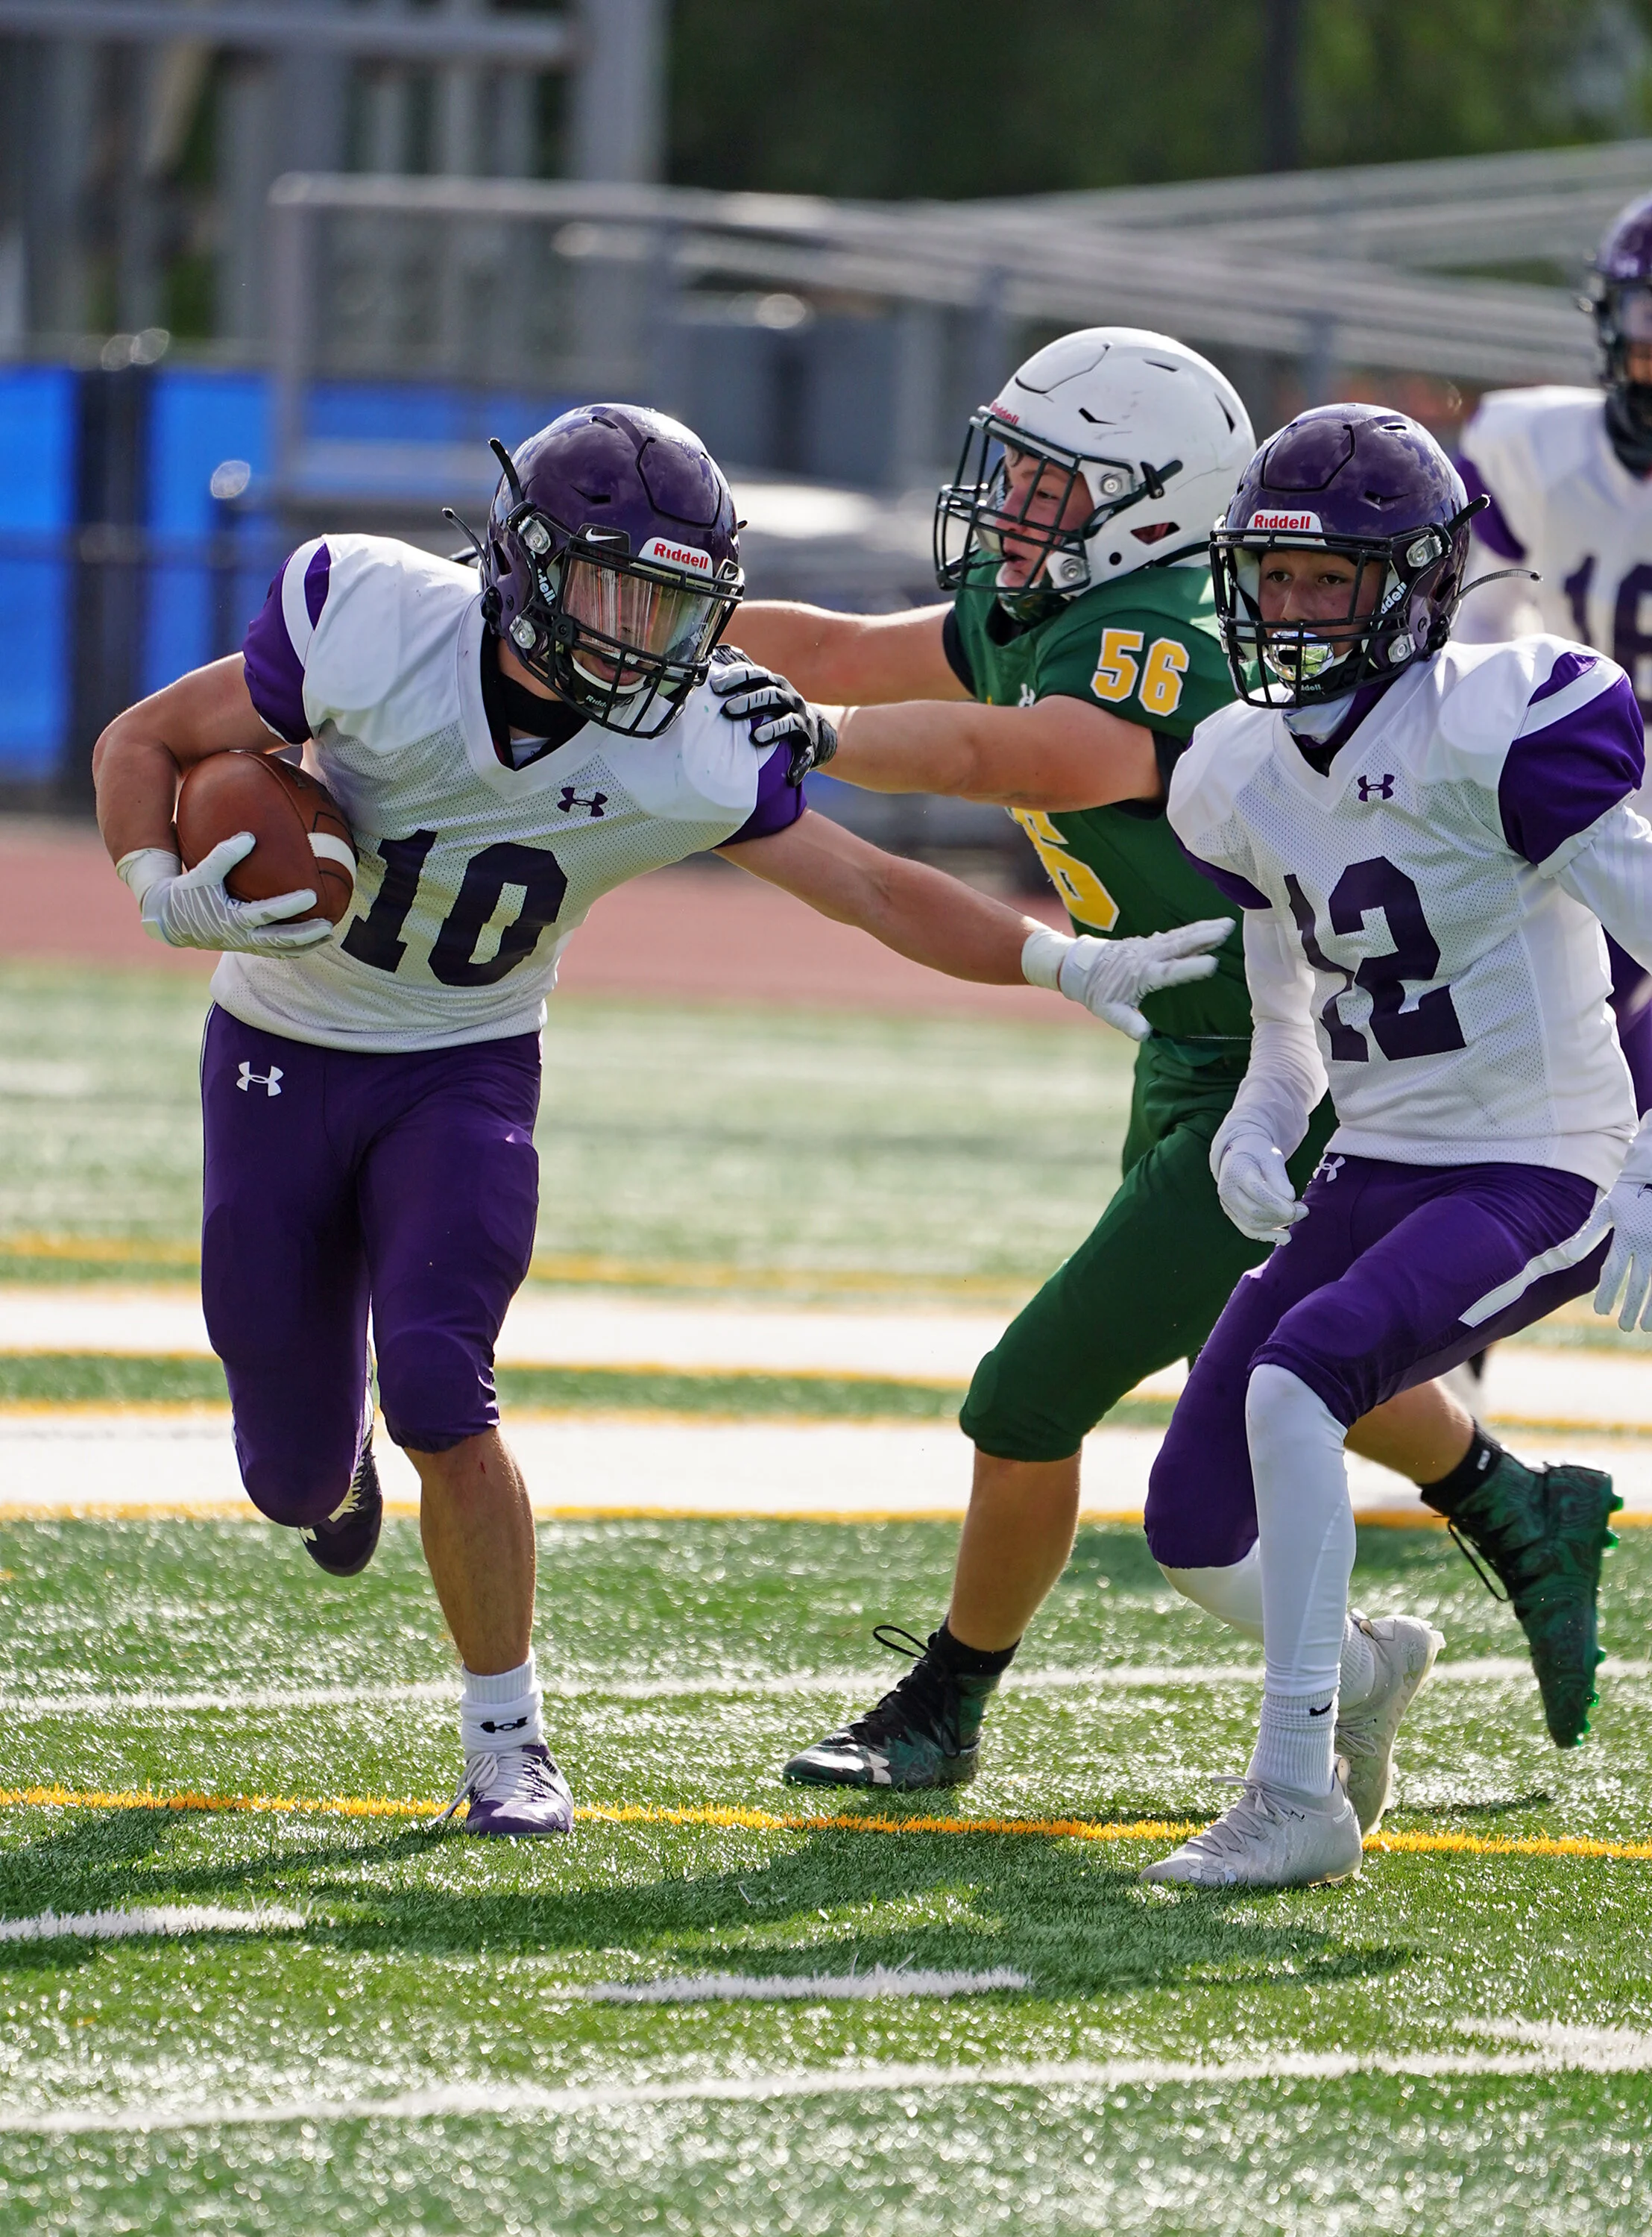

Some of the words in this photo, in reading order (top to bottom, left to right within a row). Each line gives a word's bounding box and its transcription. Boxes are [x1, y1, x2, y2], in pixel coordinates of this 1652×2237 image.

[654, 543, 708, 570] Riddell
[1254, 515, 1311, 529] Riddell
[1090, 628, 1190, 717] 56
[341, 828, 568, 987] 10
[1284, 855, 1467, 1063] 12
